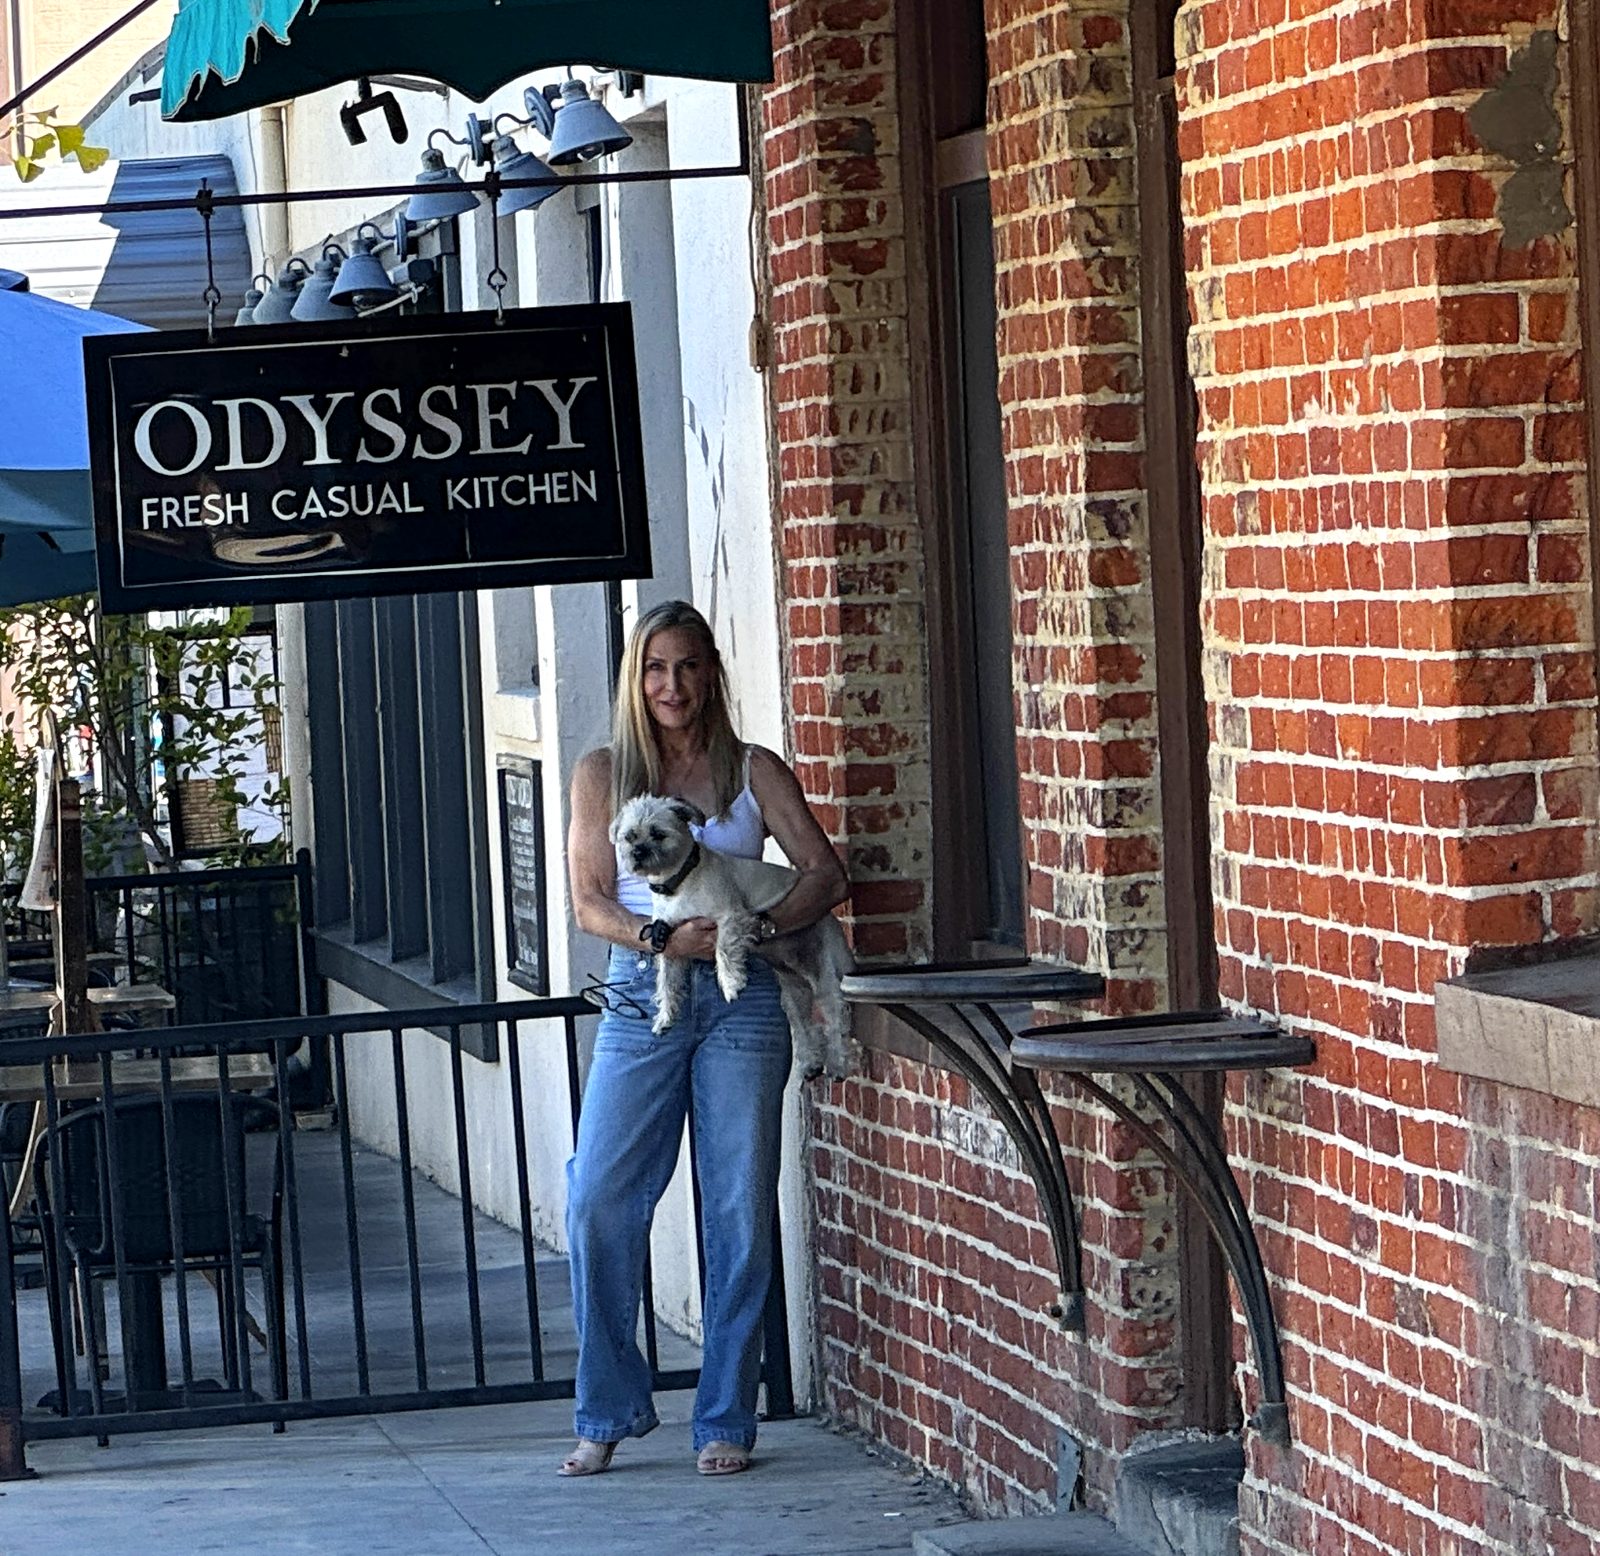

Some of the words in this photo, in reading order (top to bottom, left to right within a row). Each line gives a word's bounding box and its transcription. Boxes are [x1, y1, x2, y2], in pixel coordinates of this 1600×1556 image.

[134, 377, 598, 477] ODYSSEY
[142, 492, 249, 530] FRESH
[271, 482, 424, 521] CASUAL
[446, 470, 597, 510] KITCHEN
